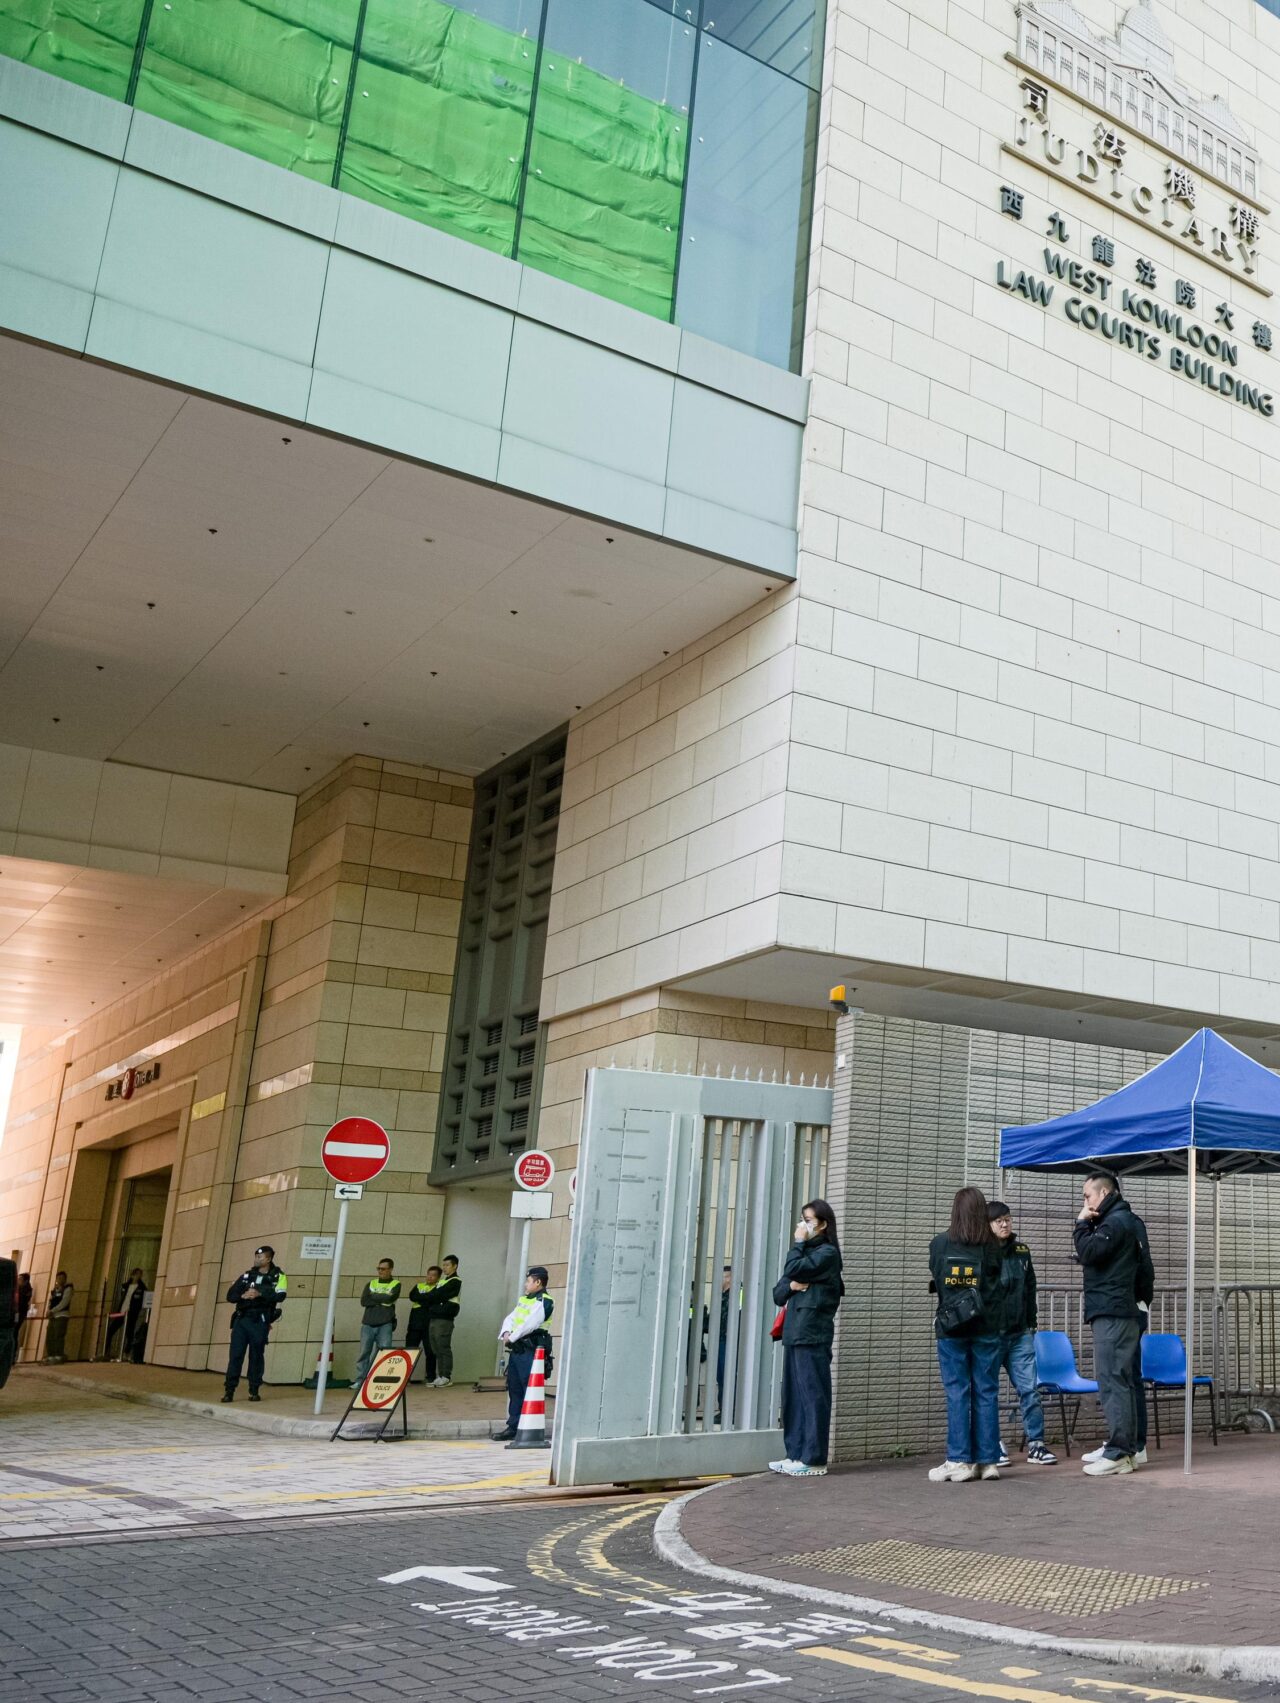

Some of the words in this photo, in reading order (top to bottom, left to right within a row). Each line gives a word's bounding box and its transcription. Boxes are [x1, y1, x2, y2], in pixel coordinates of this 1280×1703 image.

[1016, 117, 1260, 275] JUDICIARY
[1000, 185, 1273, 351] 西九龍法院大樓
[1043, 248, 1112, 301] WEST
[1122, 288, 1238, 367] KOWLOON
[997, 260, 1055, 307] LAW
[1064, 297, 1161, 361] COURTS
[1170, 347, 1274, 417] BUILDING
[945, 1278, 977, 1286] POLICE
[410, 1596, 610, 1641] RIGHT
[624, 1592, 897, 1650] 望右
[556, 1636, 794, 1695] LOOK
